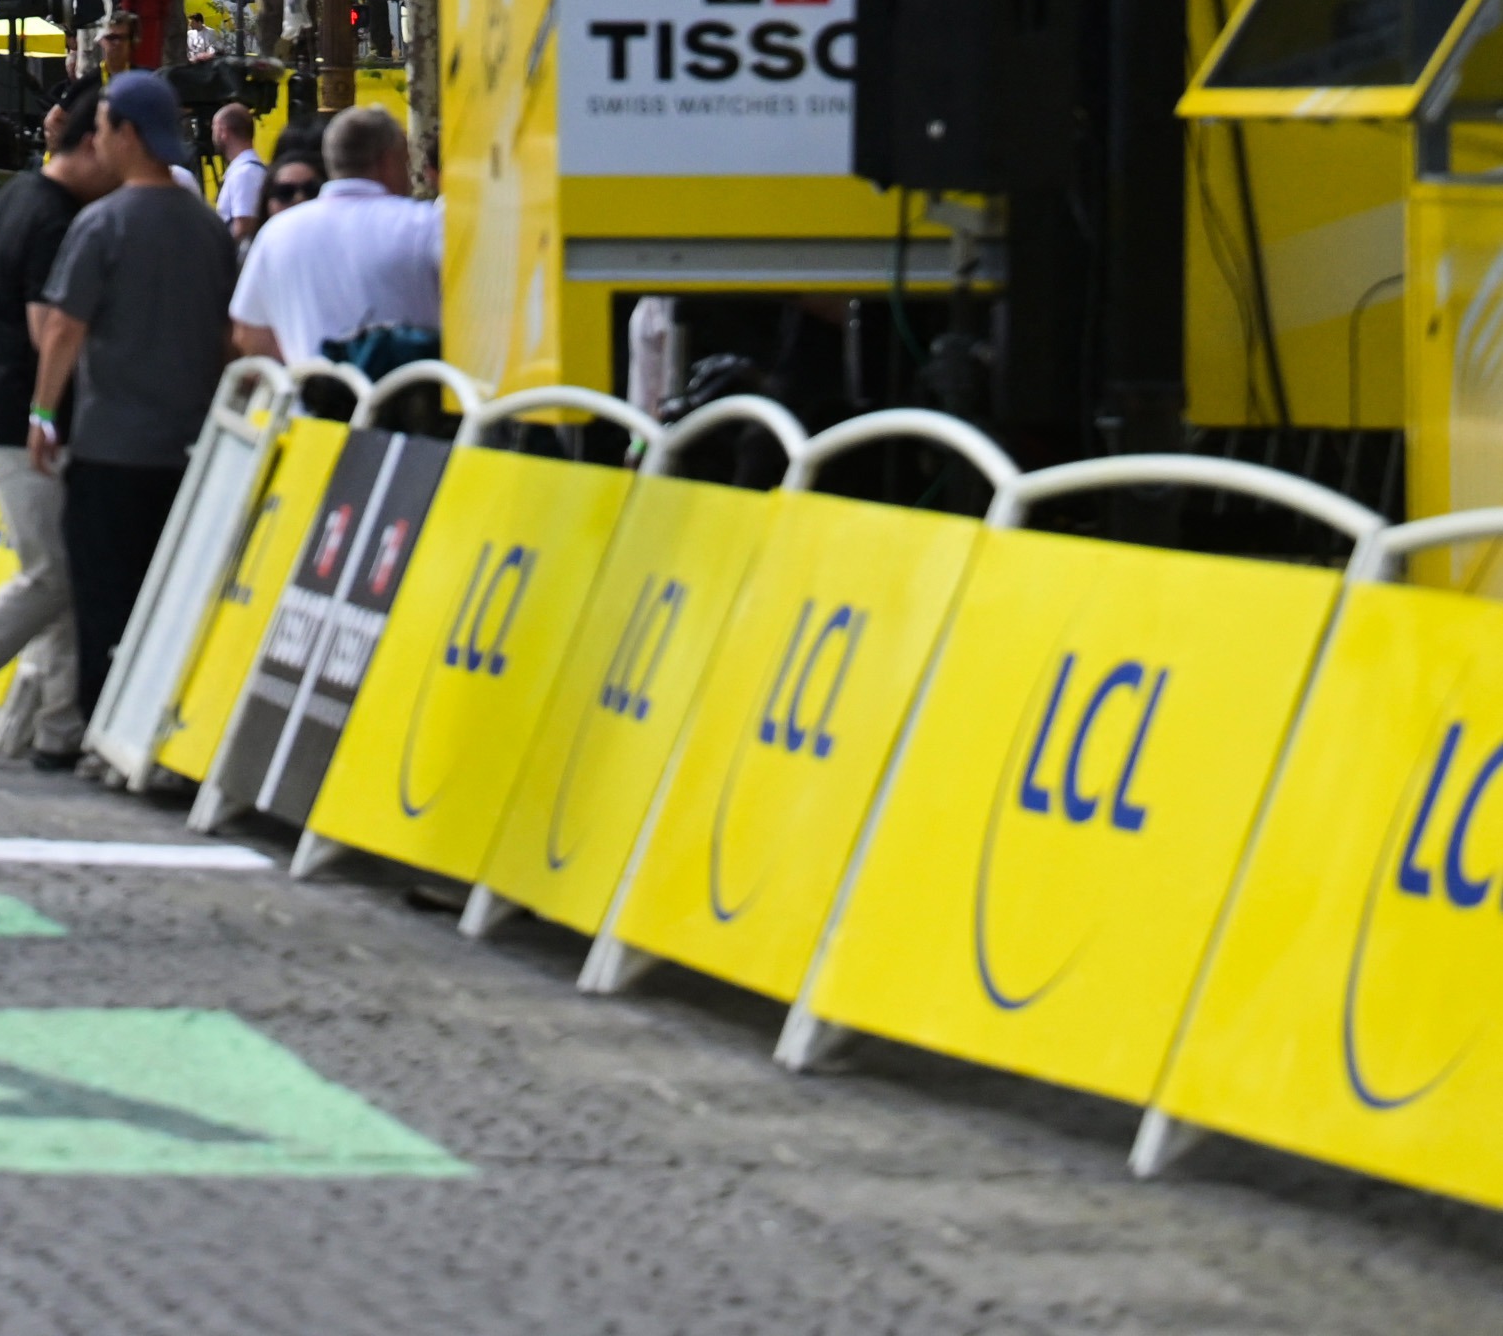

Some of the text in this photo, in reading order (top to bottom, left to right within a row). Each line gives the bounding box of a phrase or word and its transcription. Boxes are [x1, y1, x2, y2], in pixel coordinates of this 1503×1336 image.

[587, 95, 853, 116] SWISS WATCHES SIN
[588, 19, 856, 82] TISSO
[444, 541, 538, 675] LCL
[598, 574, 686, 720] LCL
[759, 599, 869, 758] LCL
[1017, 650, 1170, 831] LCL
[1397, 720, 1503, 910] LC
